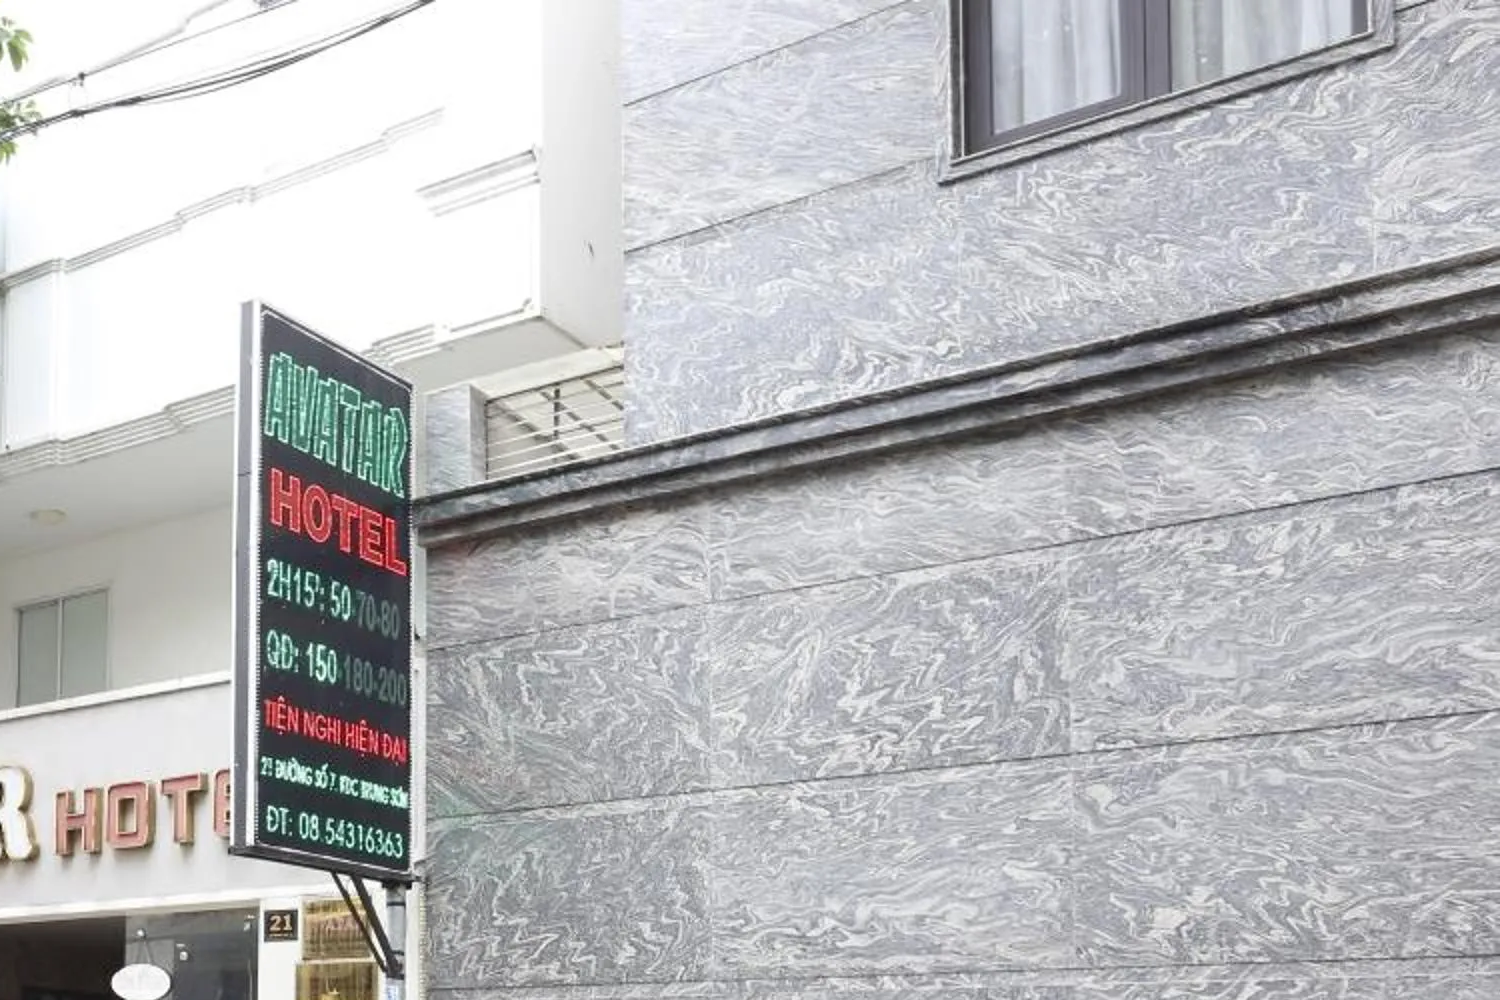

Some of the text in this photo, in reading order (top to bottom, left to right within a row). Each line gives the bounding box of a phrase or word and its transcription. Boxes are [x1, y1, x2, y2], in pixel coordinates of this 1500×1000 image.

[264, 352, 408, 498] AVATAR
[270, 467, 407, 576] HOTEL
[264, 696, 407, 766] TIỆN NGHI HIỆN ĐẠI
[266, 805, 403, 859] ĐT: 08.54316363
[269, 913, 293, 932] 21
